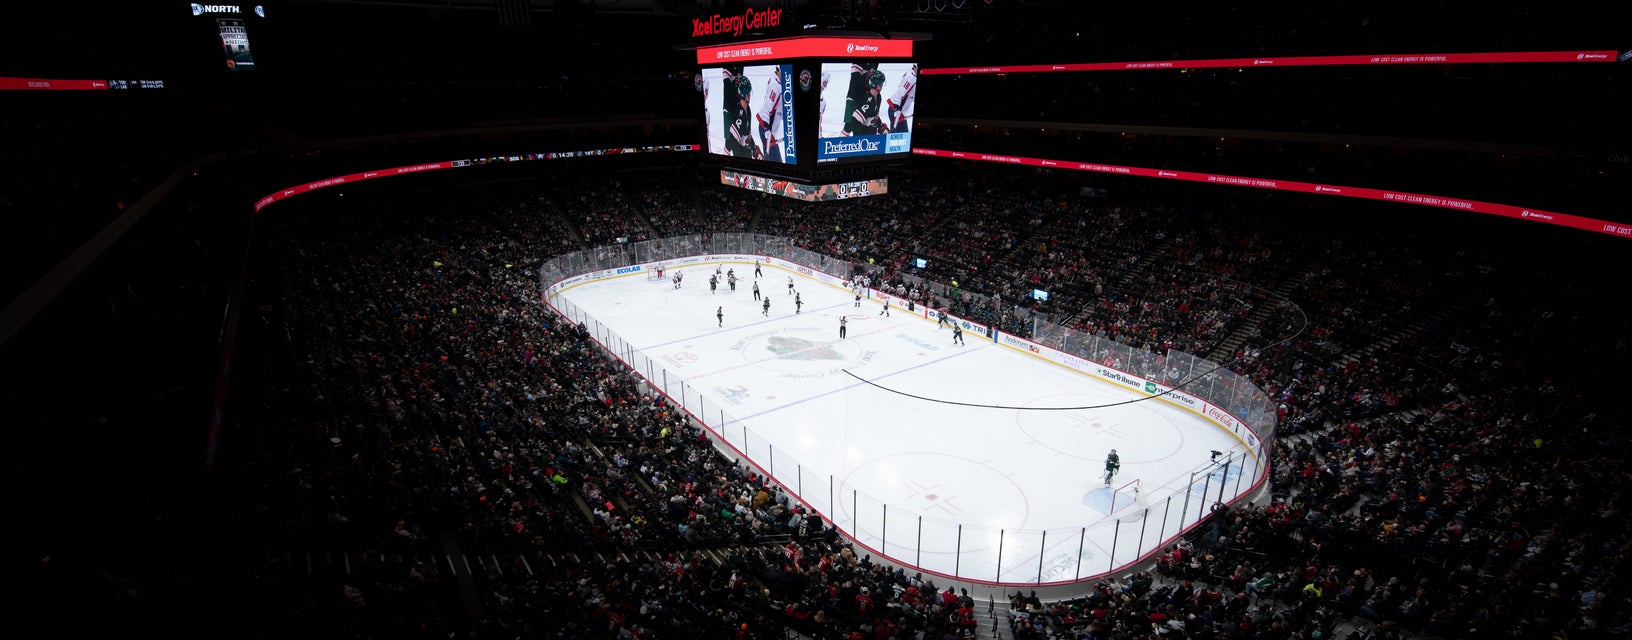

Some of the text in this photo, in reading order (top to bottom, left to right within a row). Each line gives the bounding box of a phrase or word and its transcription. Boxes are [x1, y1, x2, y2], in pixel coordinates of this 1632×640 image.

[692, 7, 782, 37] Xcel Energy Center
[784, 73, 795, 158] PreferredOne
[824, 138, 880, 154] PreferredOne
[840, 185, 846, 193] 0
[861, 183, 867, 191] 0
[1603, 224, 1632, 235] LOW COST
[617, 266, 641, 274] ECOLAB
[1004, 335, 1029, 348] Andersen
[1102, 369, 1141, 388] StarTribune
